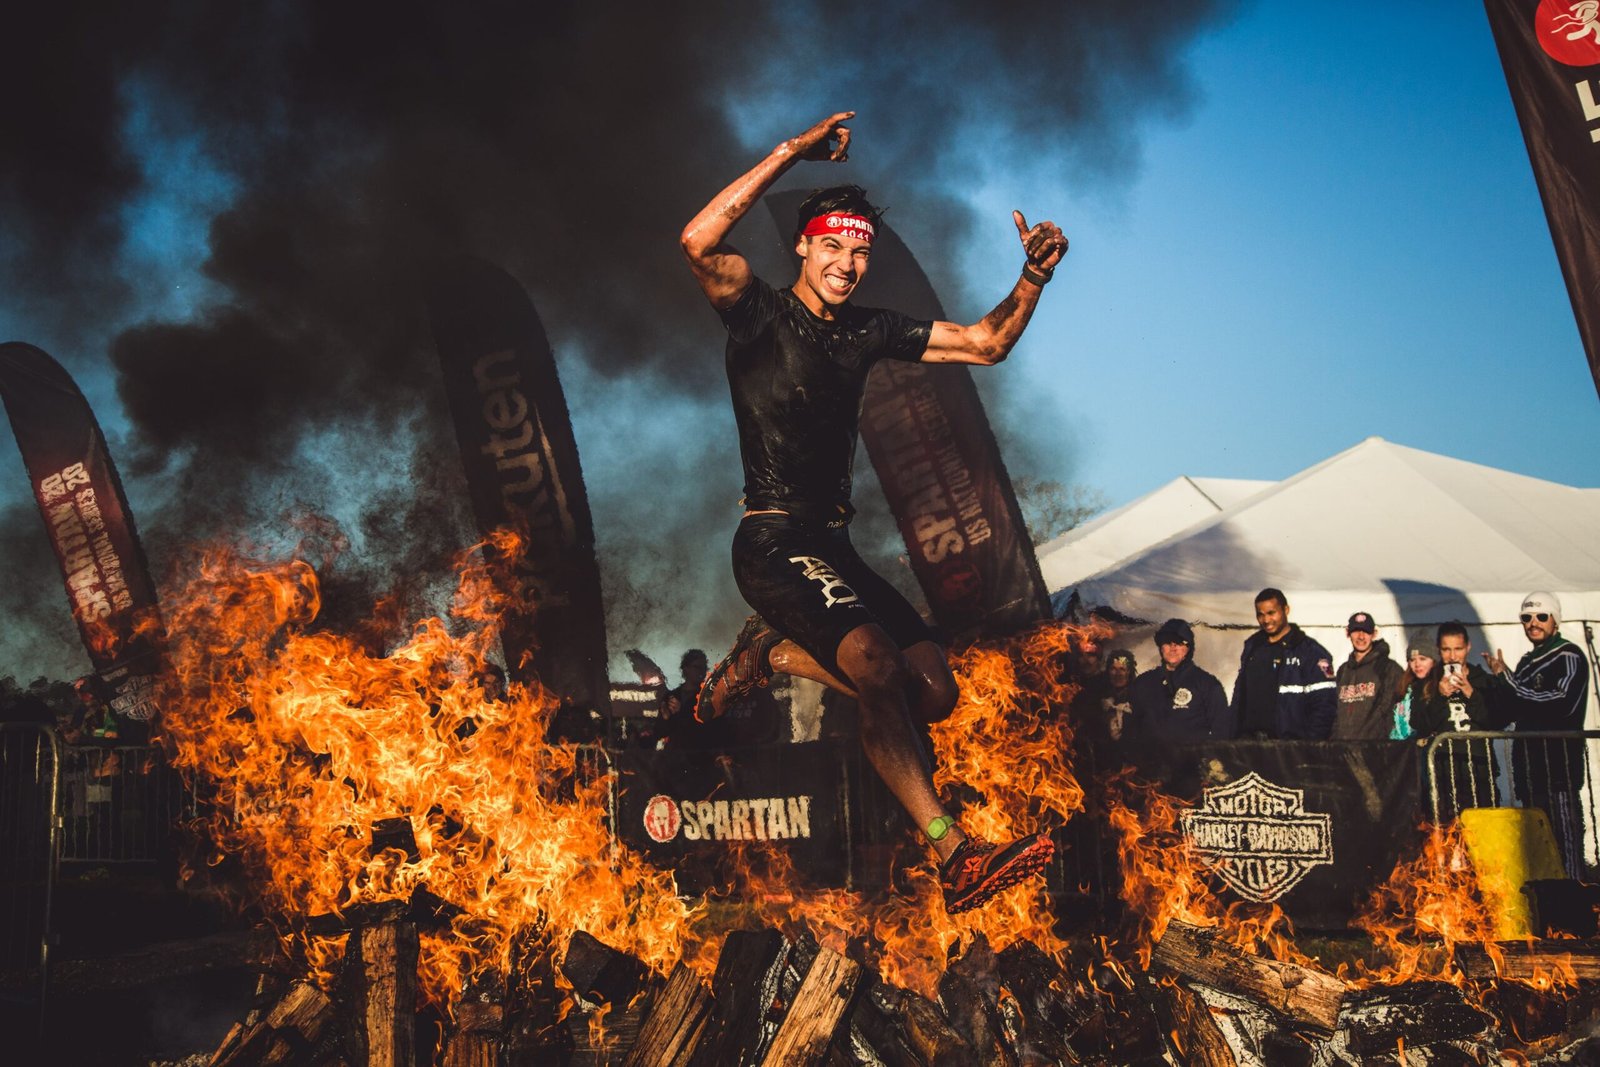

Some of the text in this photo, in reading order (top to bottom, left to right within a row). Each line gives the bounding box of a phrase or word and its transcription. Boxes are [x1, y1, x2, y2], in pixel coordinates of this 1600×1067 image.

[843, 217, 875, 236] SPARTA
[63, 461, 91, 491] 20
[48, 501, 110, 622] SPARTAN
[1219, 787, 1287, 815] MOTOR
[681, 796, 811, 840] SPARTAN
[1192, 822, 1319, 850] HARLEY-DAVIDSON
